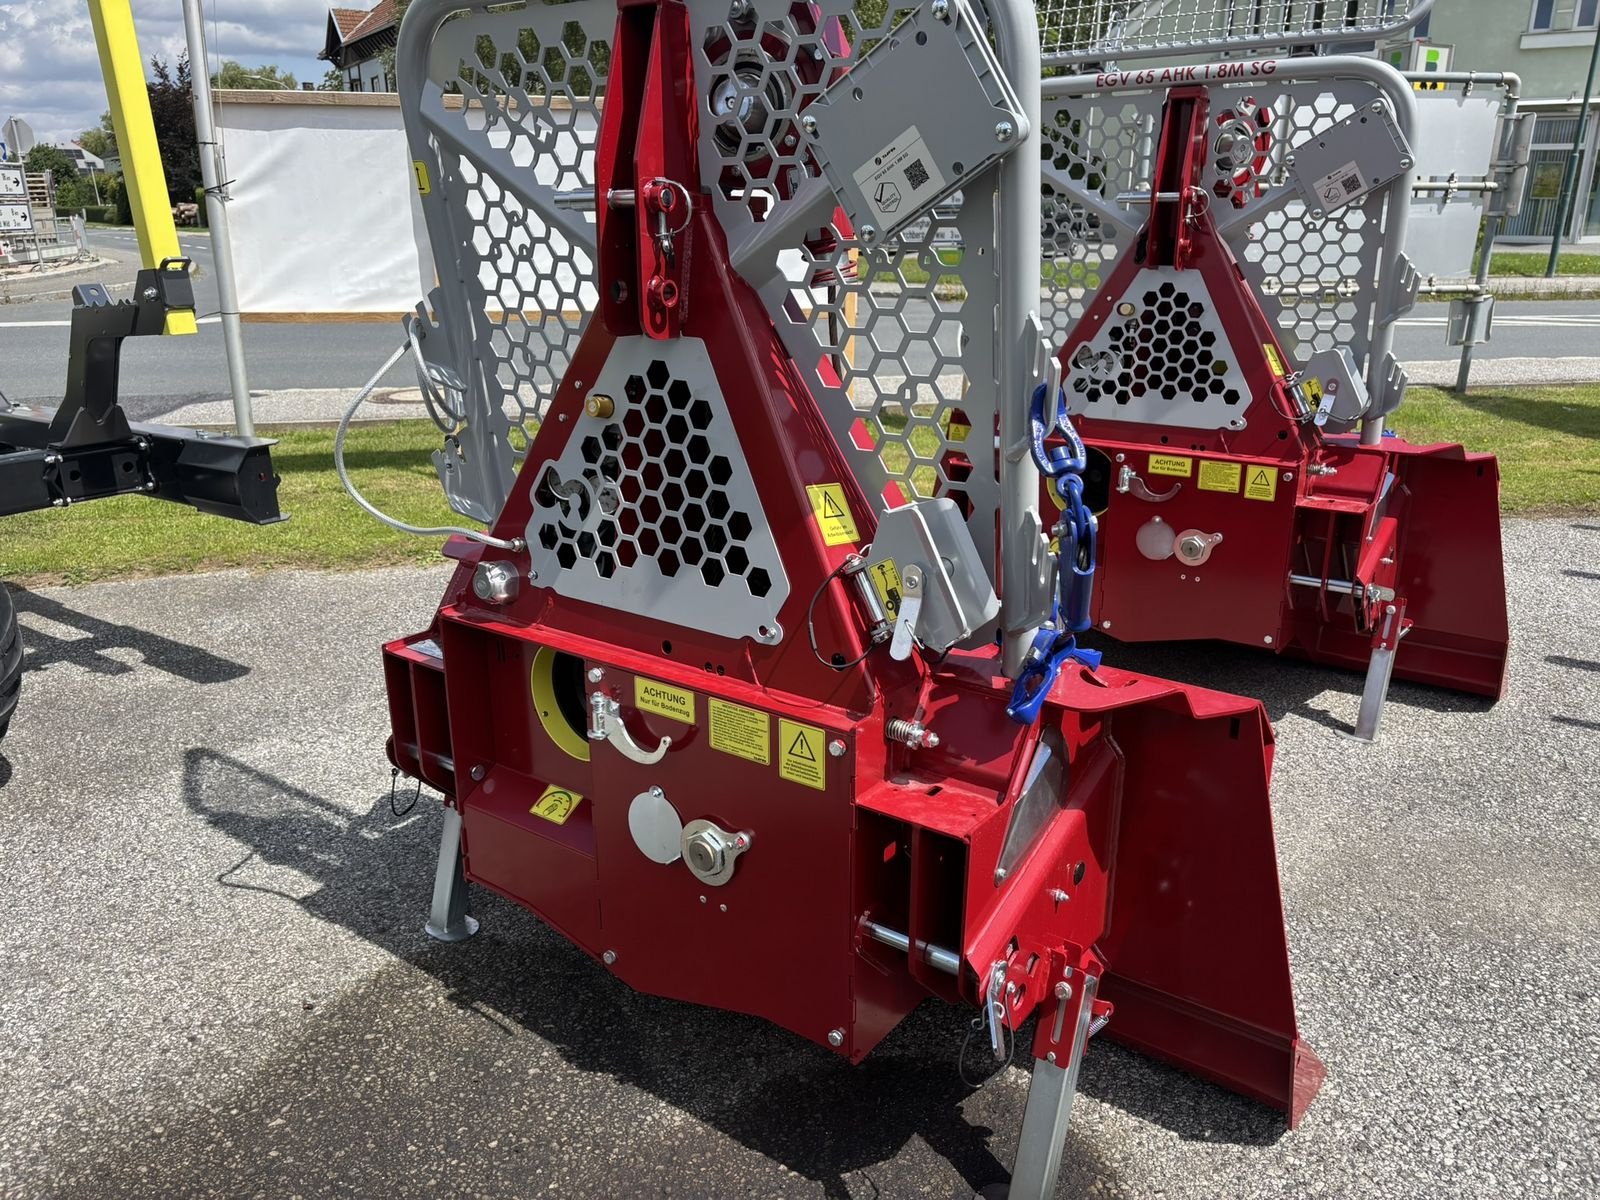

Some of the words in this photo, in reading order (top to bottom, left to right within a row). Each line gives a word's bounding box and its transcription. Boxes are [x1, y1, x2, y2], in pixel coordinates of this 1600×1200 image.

[1096, 73, 1130, 87] EGV
[1136, 70, 1155, 84] 65
[1160, 66, 1196, 82] AHK
[1204, 62, 1244, 79] 1.8M
[1250, 60, 1277, 76] SG
[1155, 458, 1186, 468] ACHTUNG
[643, 686, 686, 706] ACHTUNG
[640, 696, 651, 705] Nur
[651, 699, 660, 707] für
[660, 702, 690, 718] Bodenzug
